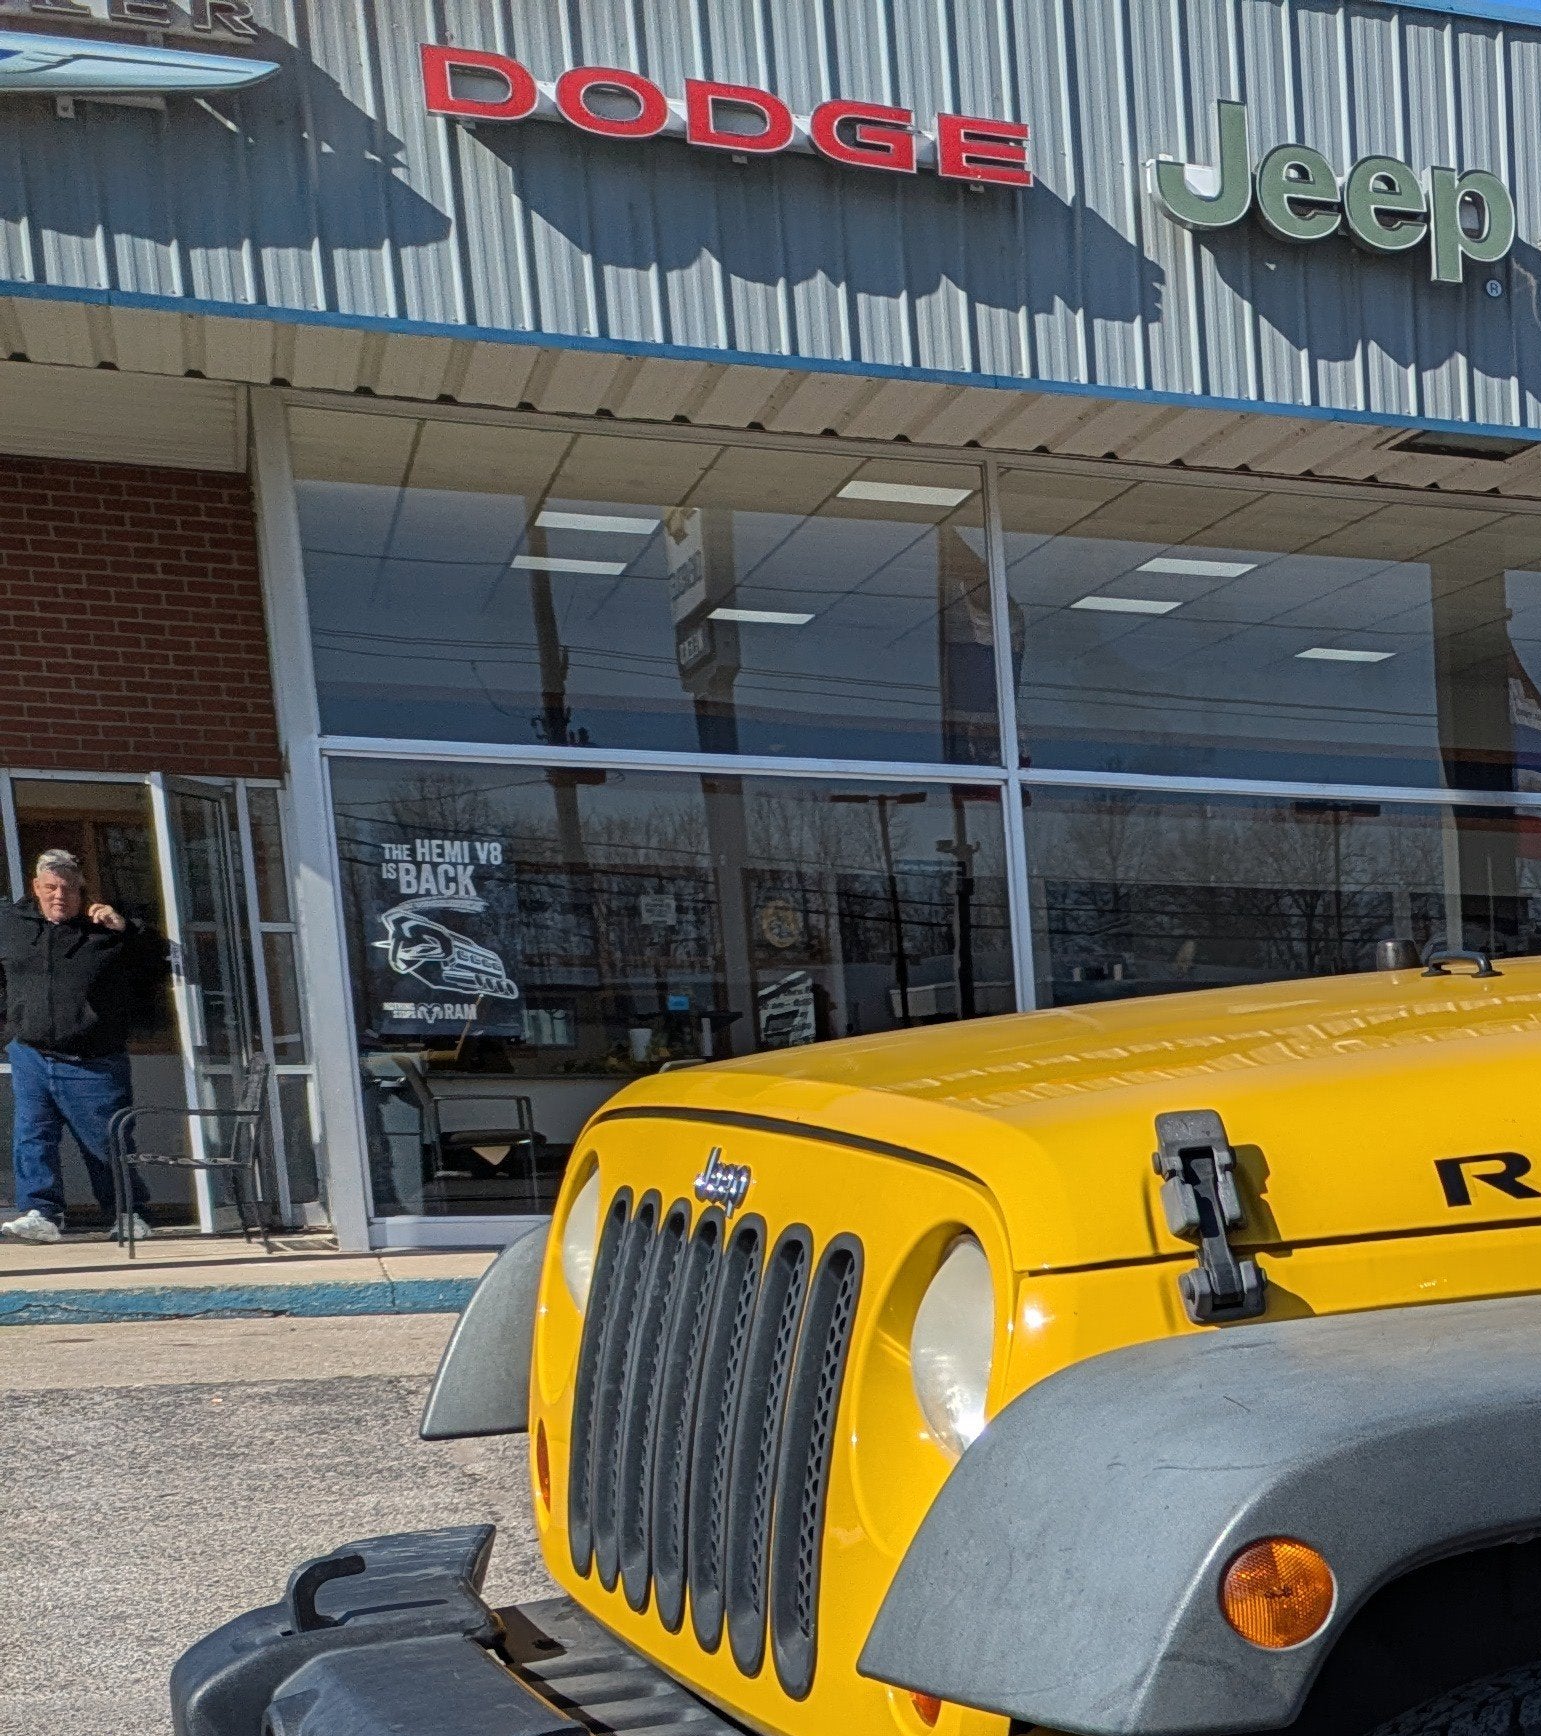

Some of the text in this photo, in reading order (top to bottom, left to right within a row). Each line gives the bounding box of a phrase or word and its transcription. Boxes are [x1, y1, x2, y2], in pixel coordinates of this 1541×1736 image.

[419, 43, 1033, 188] DODGE
[1146, 99, 1516, 283] Jeep
[381, 838, 502, 865] THE HEMI V8
[381, 862, 477, 896] IS BACK
[443, 1003, 477, 1020] RAM
[694, 1146, 751, 1219] Jeep
